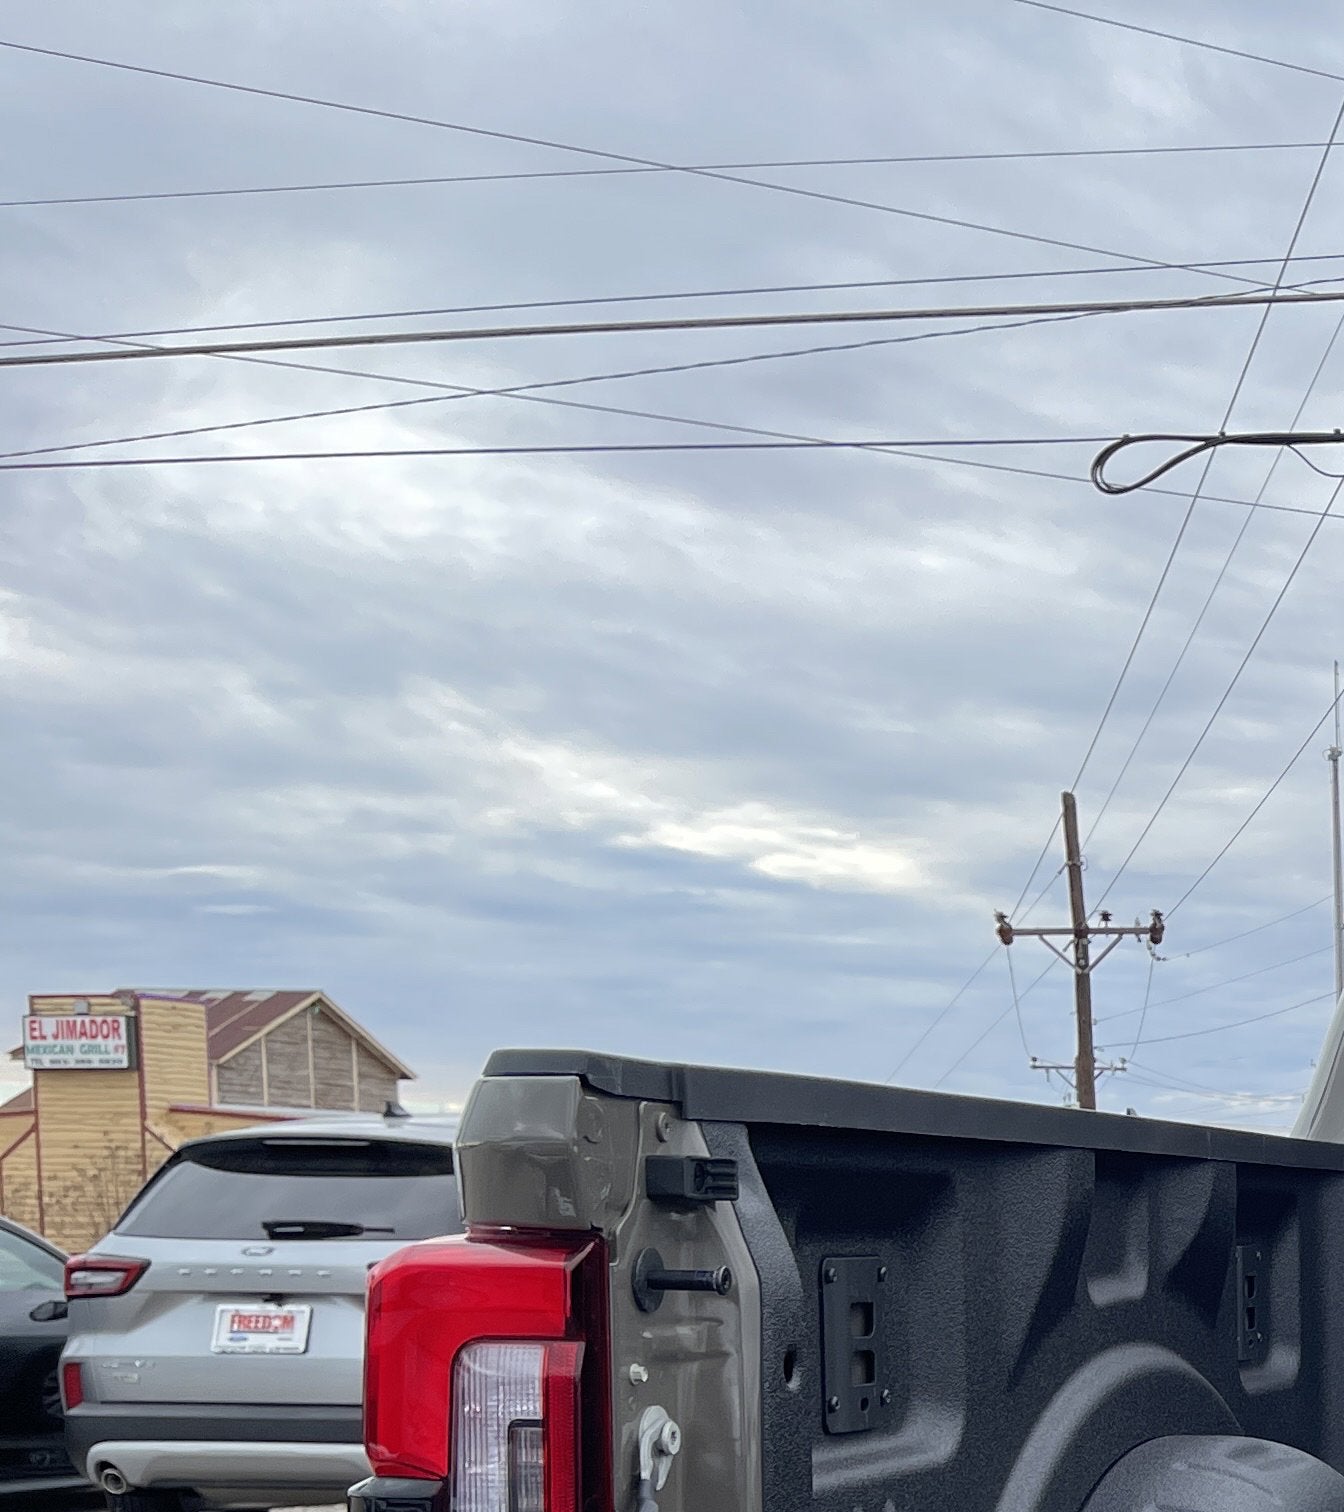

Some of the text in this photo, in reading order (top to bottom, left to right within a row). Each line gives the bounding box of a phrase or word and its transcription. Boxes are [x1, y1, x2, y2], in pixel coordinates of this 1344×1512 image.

[29, 1018, 122, 1041] EL JIMADOR
[26, 1044, 75, 1056] MEXICAN
[79, 1044, 111, 1055] GRILL
